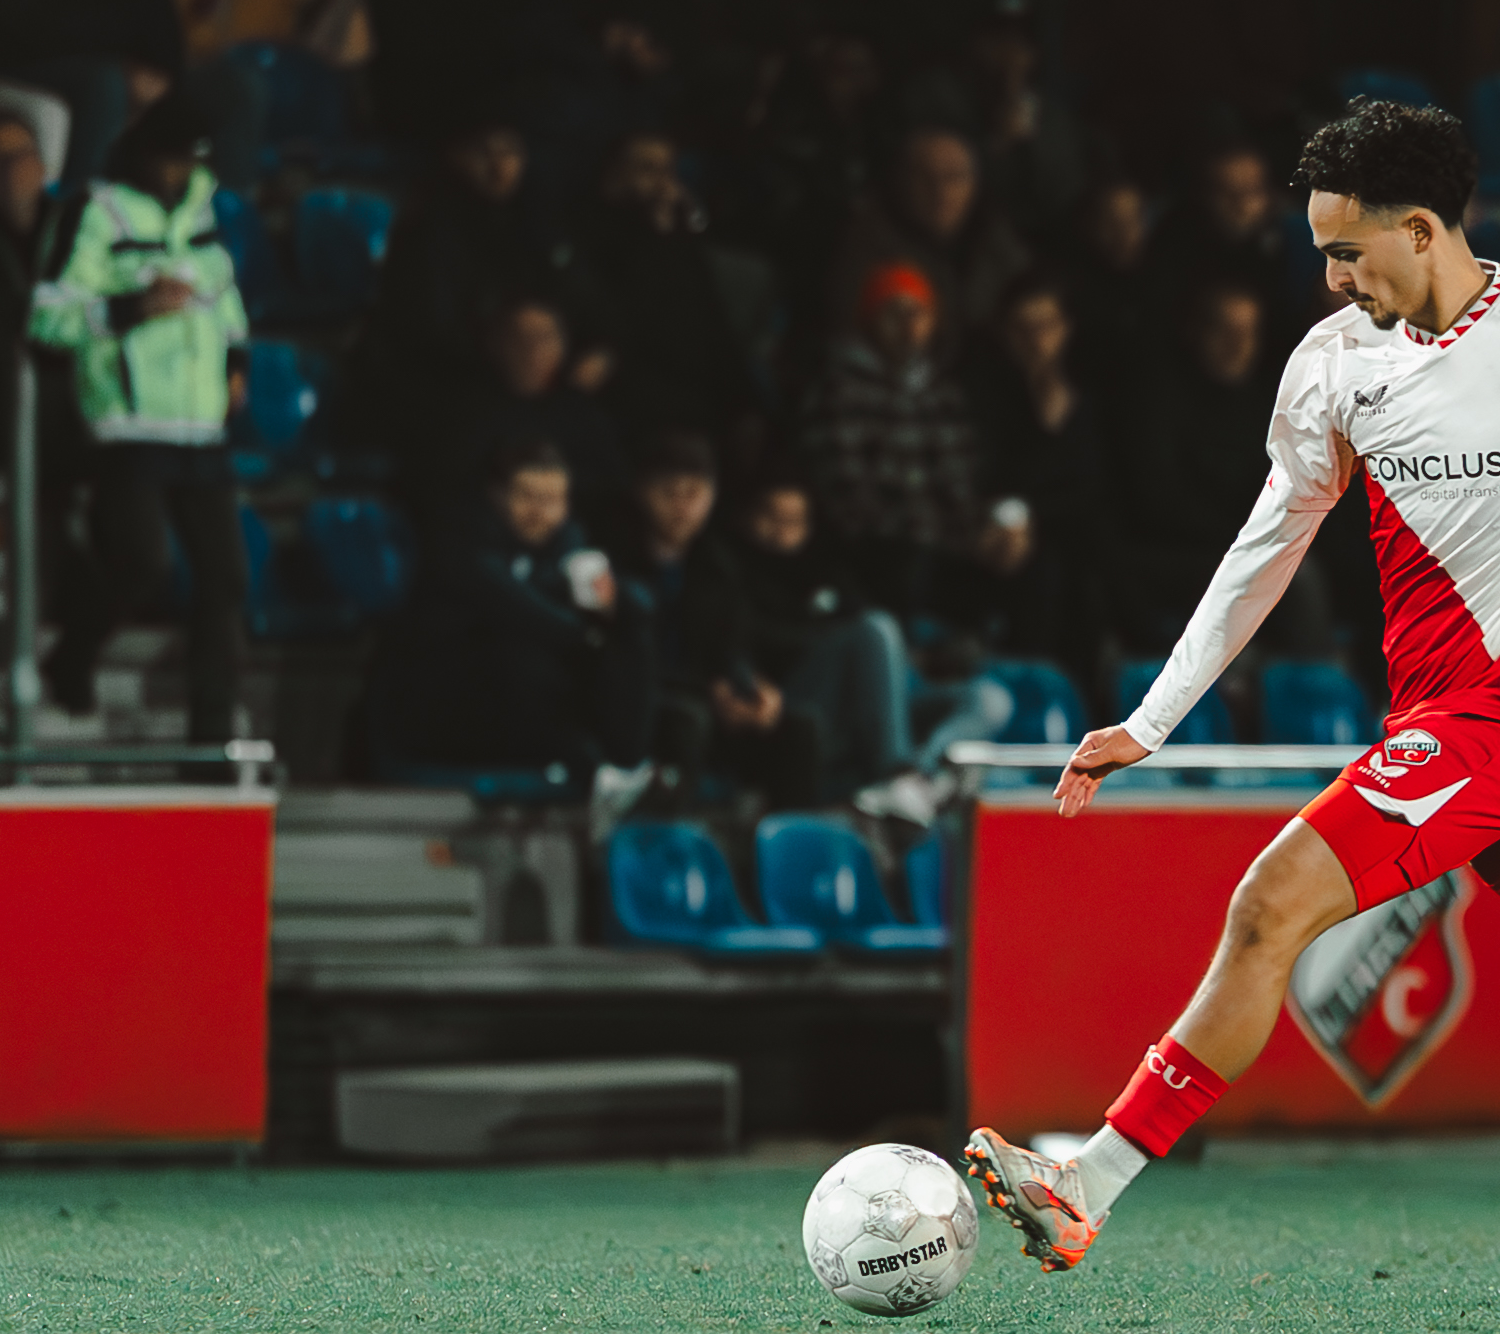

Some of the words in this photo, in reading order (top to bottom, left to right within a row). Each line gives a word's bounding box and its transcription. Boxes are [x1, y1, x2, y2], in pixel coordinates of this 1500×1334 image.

[1419, 487, 1460, 503] digital
[1382, 966, 1428, 1039] C
[857, 1235, 948, 1277] DERBYSTAR
